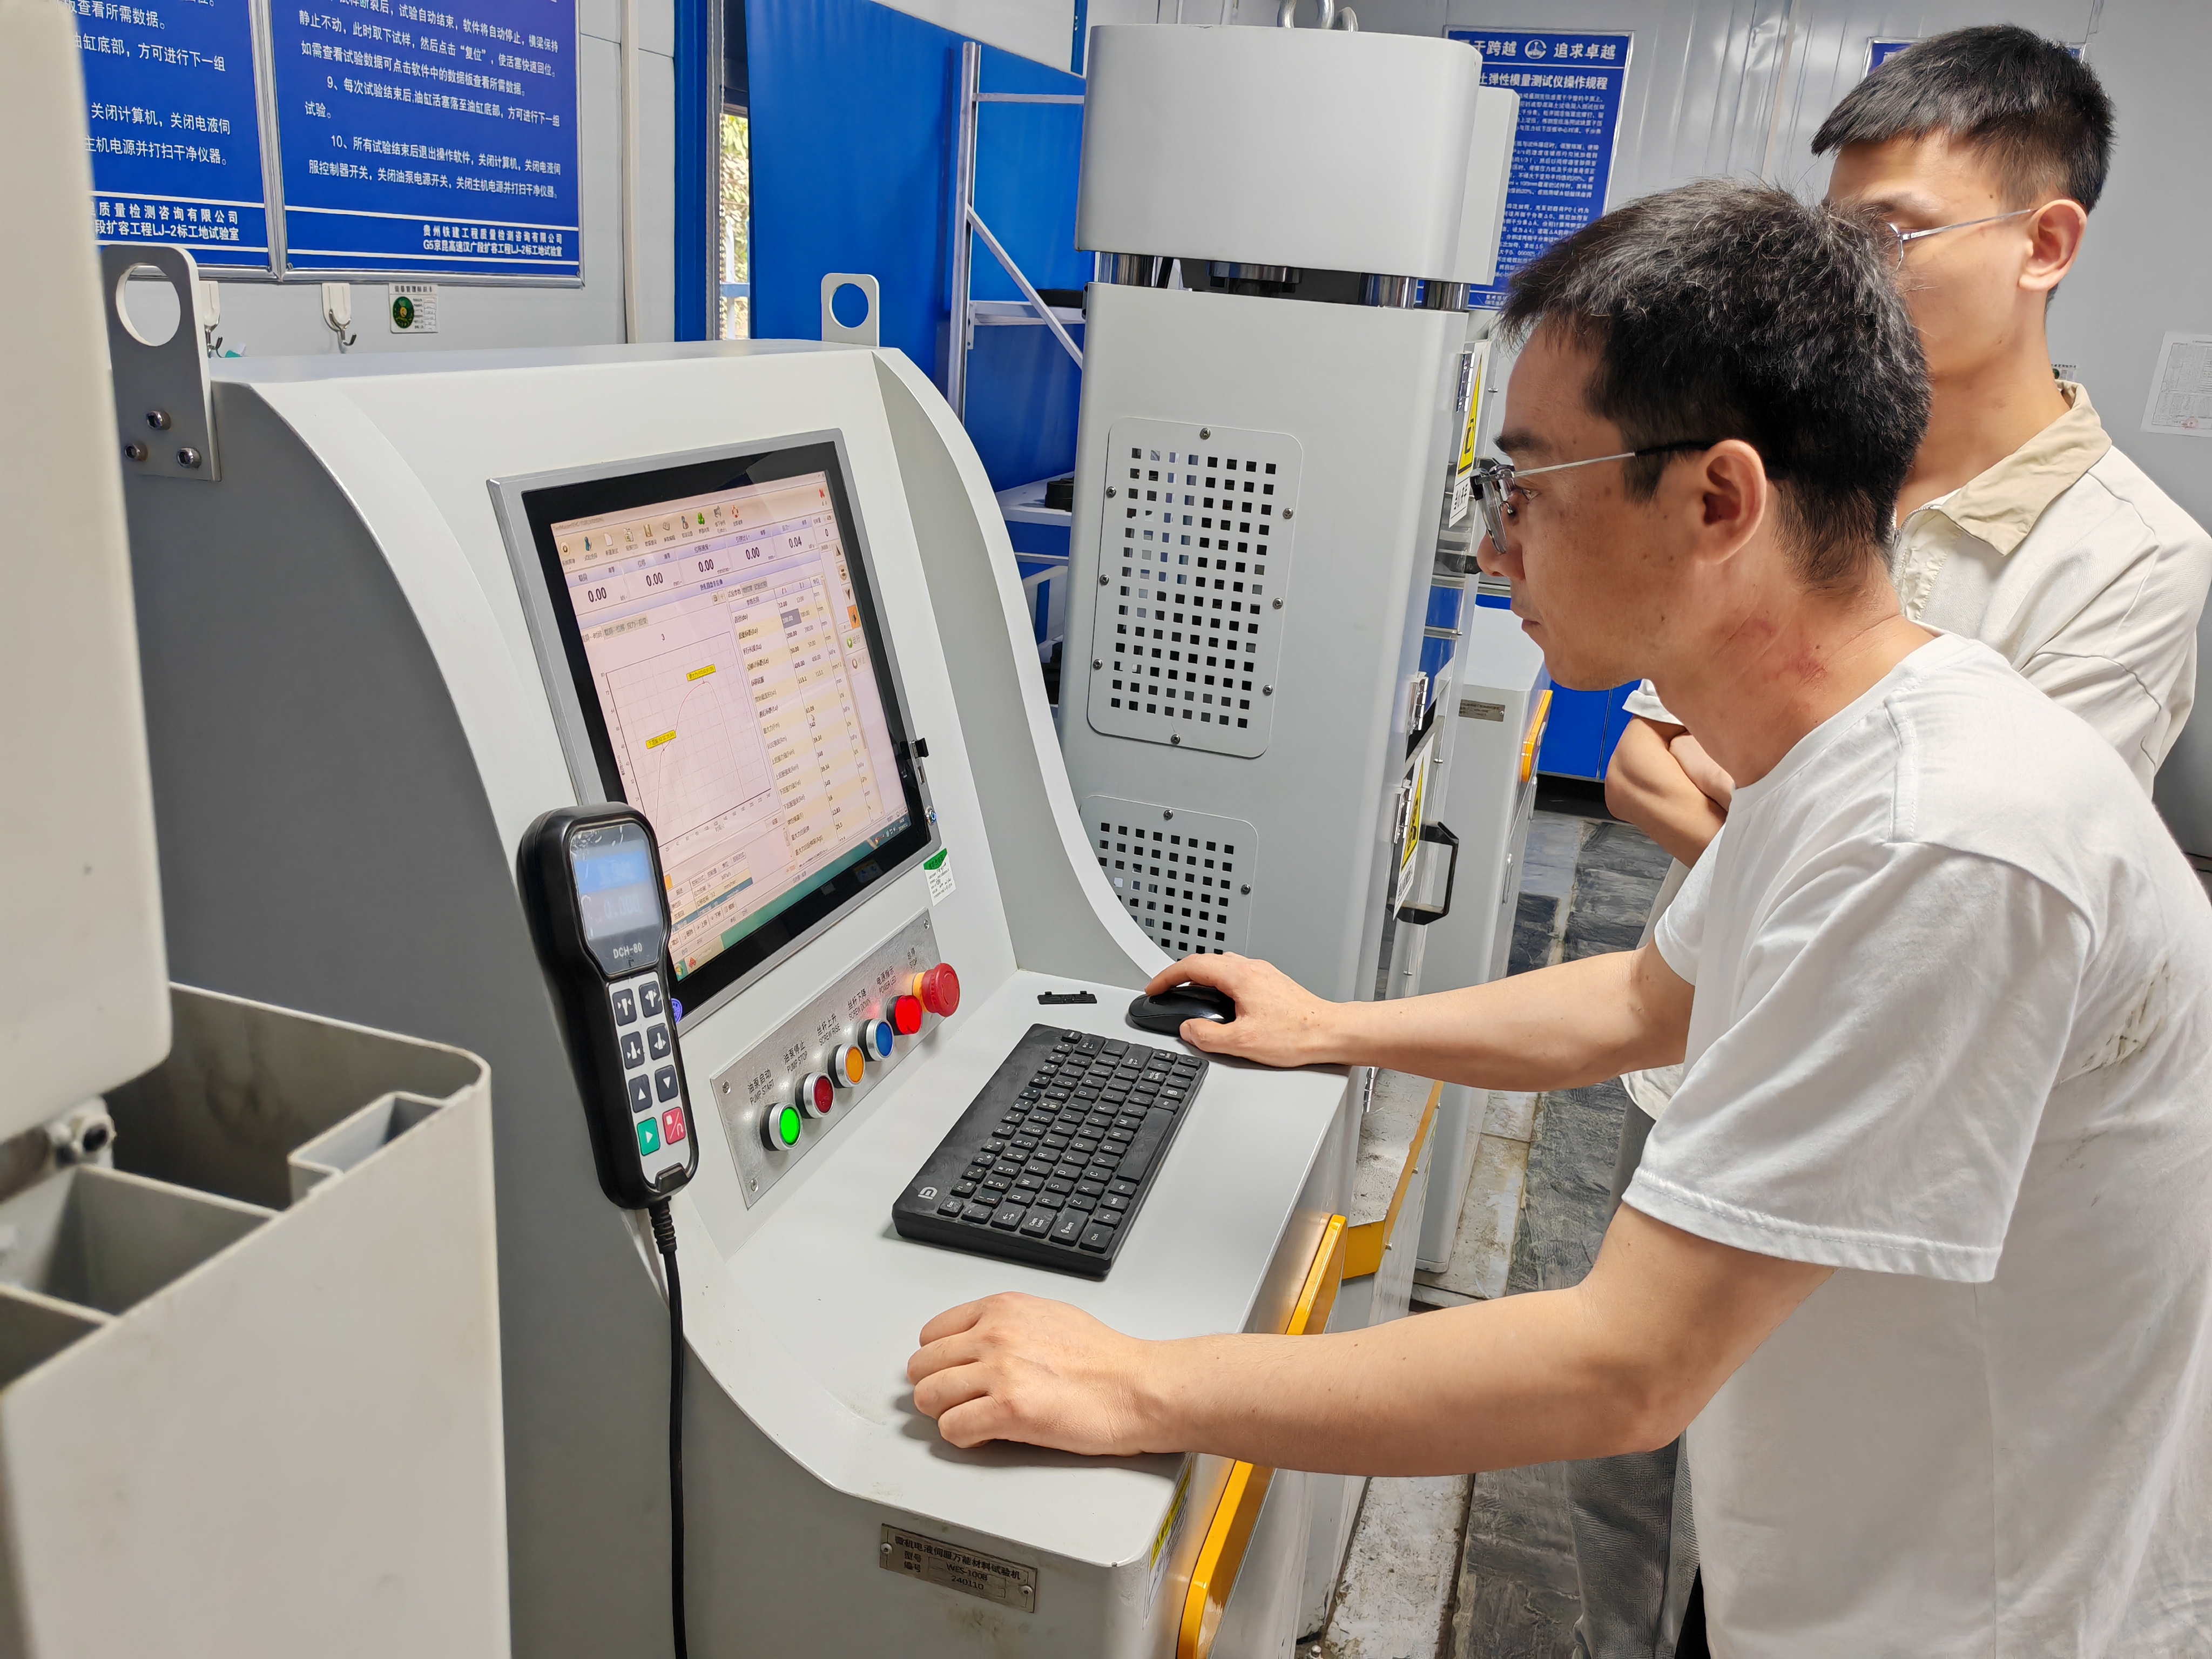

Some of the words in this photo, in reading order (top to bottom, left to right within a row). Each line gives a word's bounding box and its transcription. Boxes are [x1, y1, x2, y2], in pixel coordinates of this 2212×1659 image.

[1553, 43, 1617, 60] 追求卓越
[305, 101, 332, 119] 试验。
[586, 586, 608, 603] 0.00
[645, 571, 664, 587] 0.00
[697, 558, 714, 573] 0.00
[745, 546, 760, 560] 0.00
[787, 535, 802, 549] 0.04
[824, 528, 829, 537] 0
[660, 633, 666, 642] 3
[612, 942, 643, 959] DCH-80
[876, 966, 894, 986] 电源指示
[879, 982, 890, 995] POWER
[848, 1005, 860, 1021] SCREW
[860, 997, 872, 1011] DOWN
[817, 1013, 837, 1037] 丝杆上升
[819, 1030, 832, 1046] SCREW
[832, 1023, 841, 1035] RISE
[784, 1040, 806, 1065] 油泵停止
[786, 1061, 798, 1074] PUMP
[798, 1051, 808, 1065] STOP
[747, 1068, 772, 1095] 油泵启动
[750, 1090, 761, 1105] PUMP
[762, 1078, 775, 1096] START
[1029, 1218, 1038, 1226] Caps
[904, 1549, 922, 1563] 型号
[951, 1575, 984, 1591] 240110
